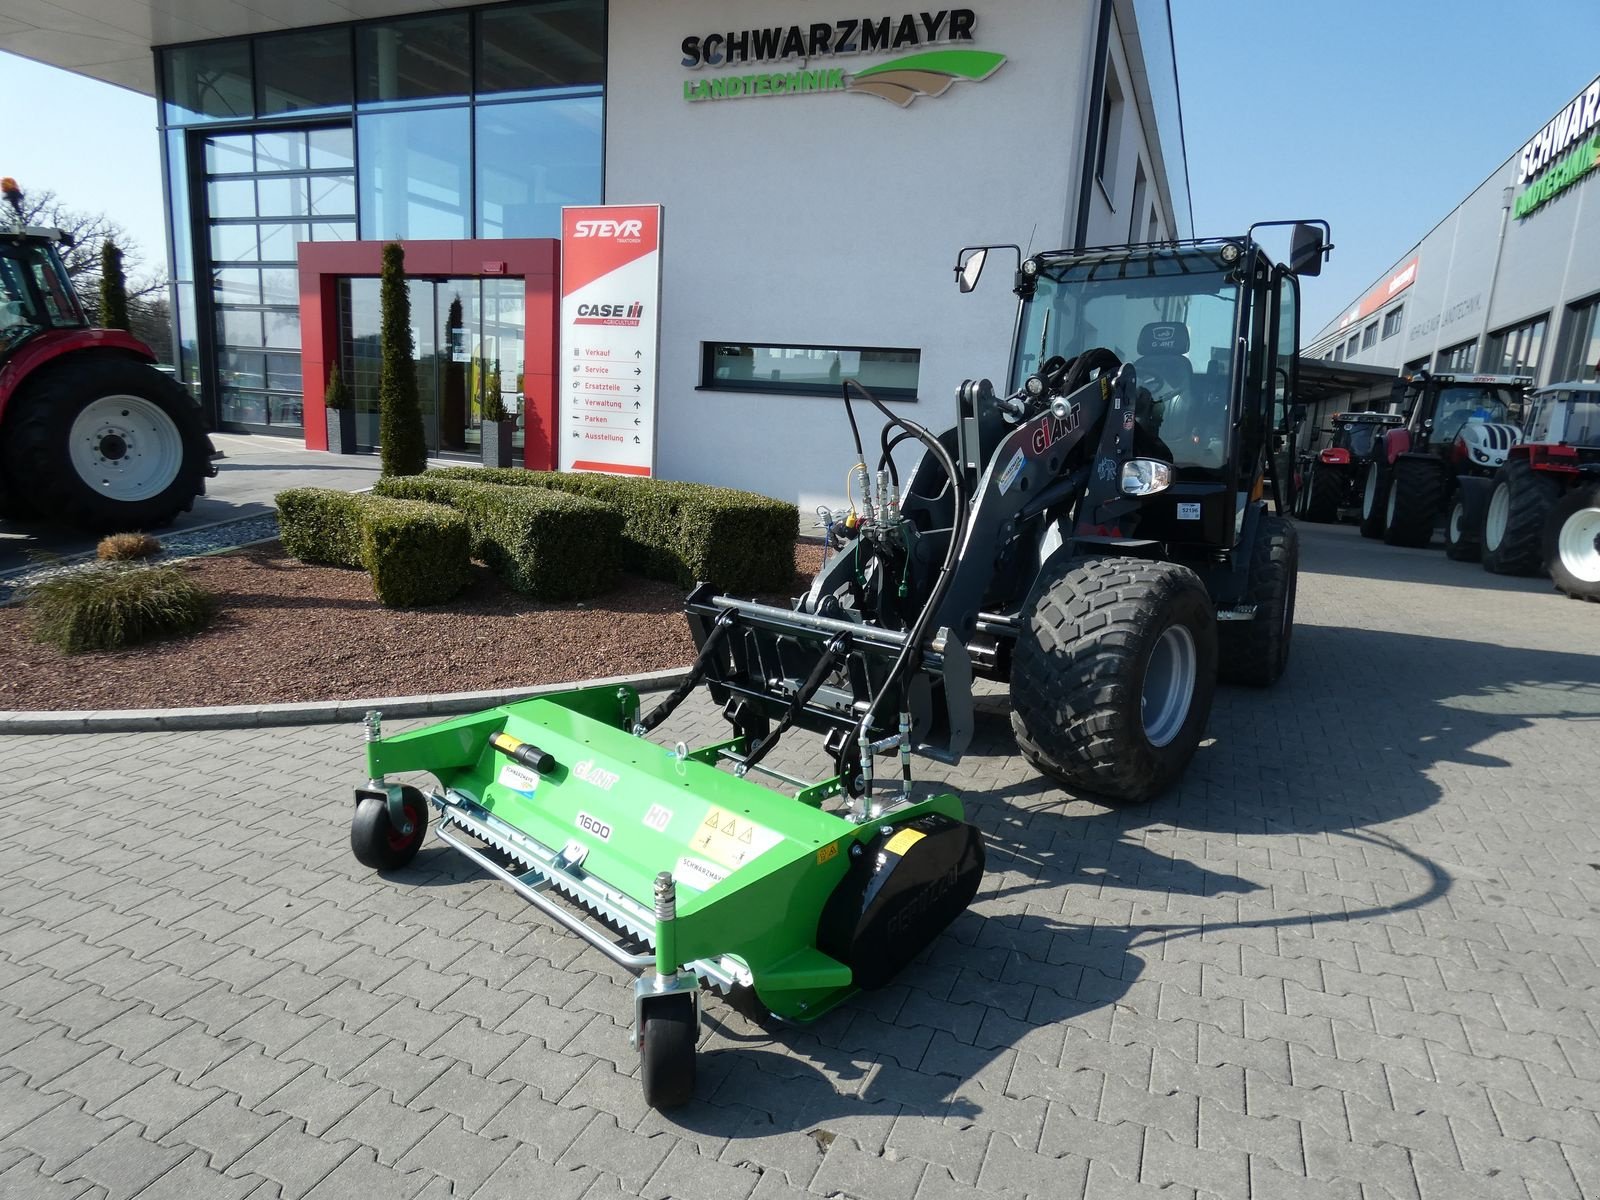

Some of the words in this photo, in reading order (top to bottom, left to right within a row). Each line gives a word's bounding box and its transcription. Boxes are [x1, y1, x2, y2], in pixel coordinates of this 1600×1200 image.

[681, 8, 976, 66] SCHWARZMAYR
[683, 68, 845, 100] LANDTECHNIK
[1513, 135, 1594, 220] LANDTECHNIK
[573, 220, 643, 238] STEYR
[577, 304, 624, 318] CASE
[585, 349, 610, 357] Verkauf
[585, 366, 609, 374] Service
[585, 382, 621, 391] Ersatzteile
[585, 398, 622, 409] Verwaltung
[585, 415, 608, 423] Parken
[585, 432, 624, 443] Ausstellung
[646, 806, 669, 828] HD
[579, 814, 611, 839] 1600
